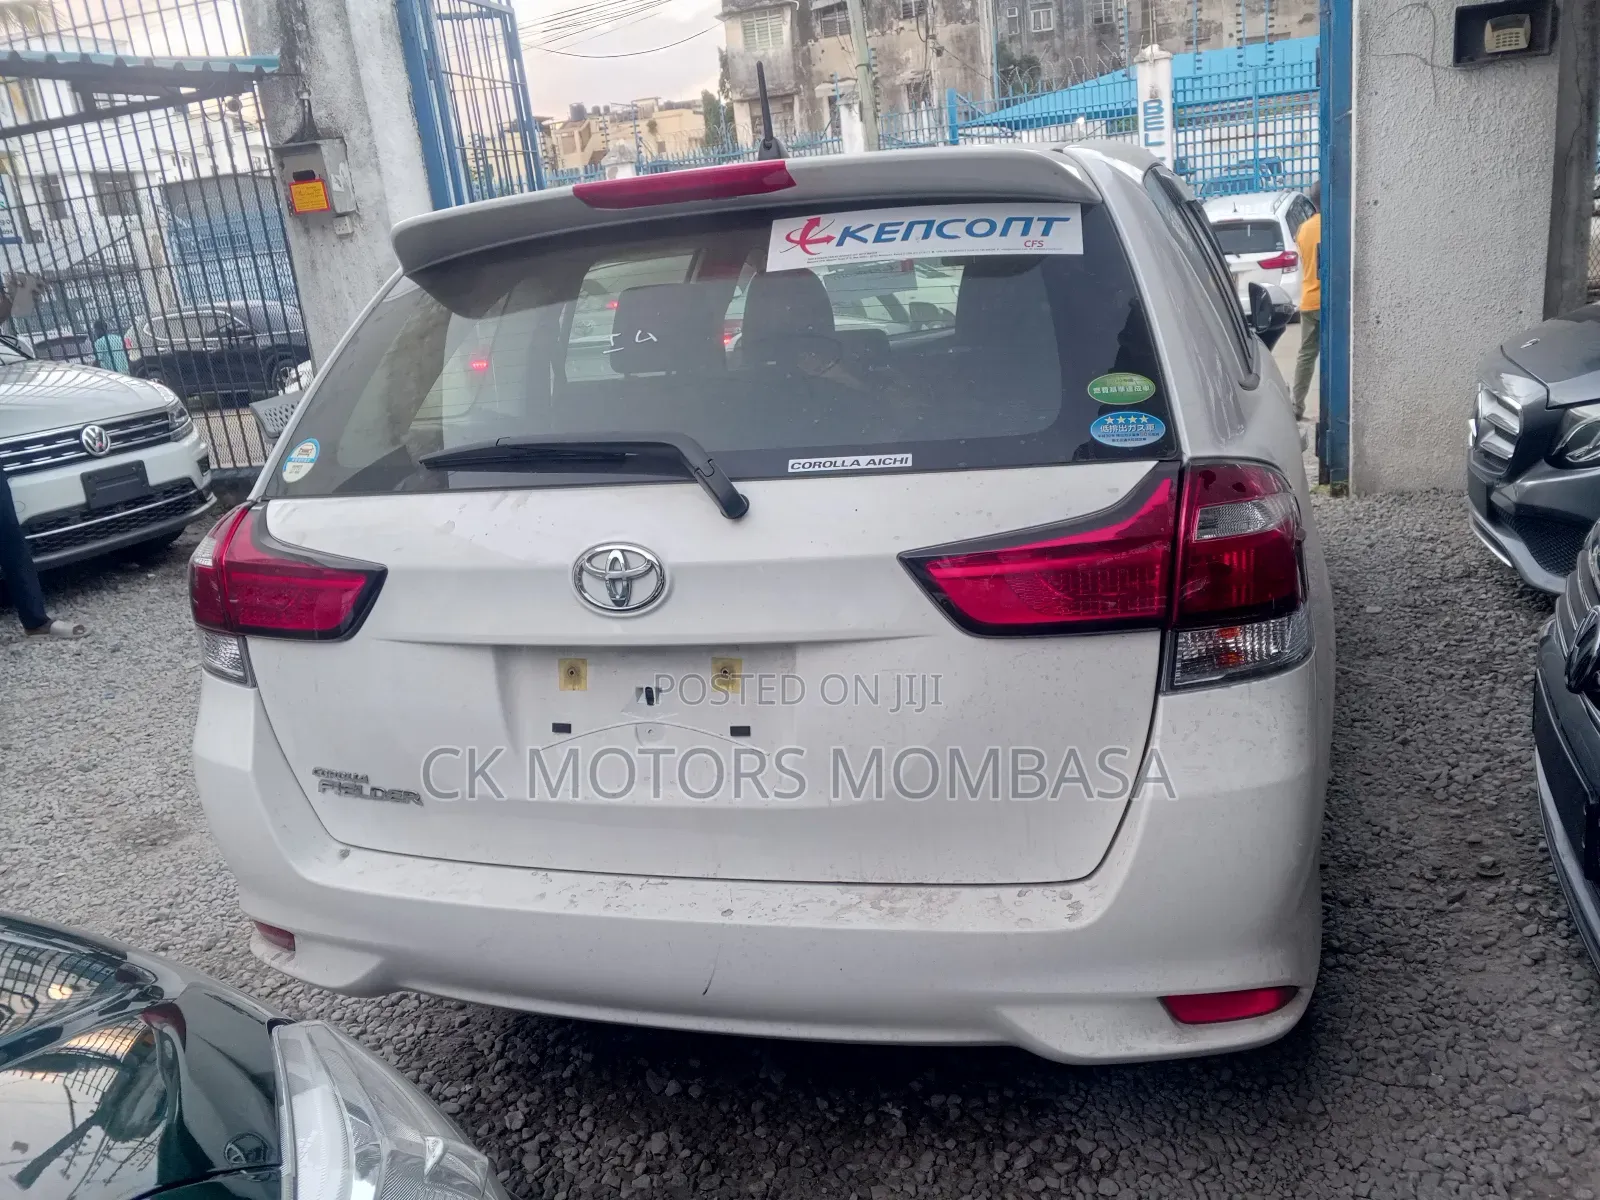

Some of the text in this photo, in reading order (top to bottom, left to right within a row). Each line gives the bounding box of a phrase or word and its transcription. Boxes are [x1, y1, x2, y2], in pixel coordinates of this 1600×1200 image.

[1023, 240, 1045, 248] CFS
[1100, 423, 1156, 434] 低排出ガス車
[790, 456, 910, 470] COROLLA AICHI
[318, 779, 424, 807] FIELDER
